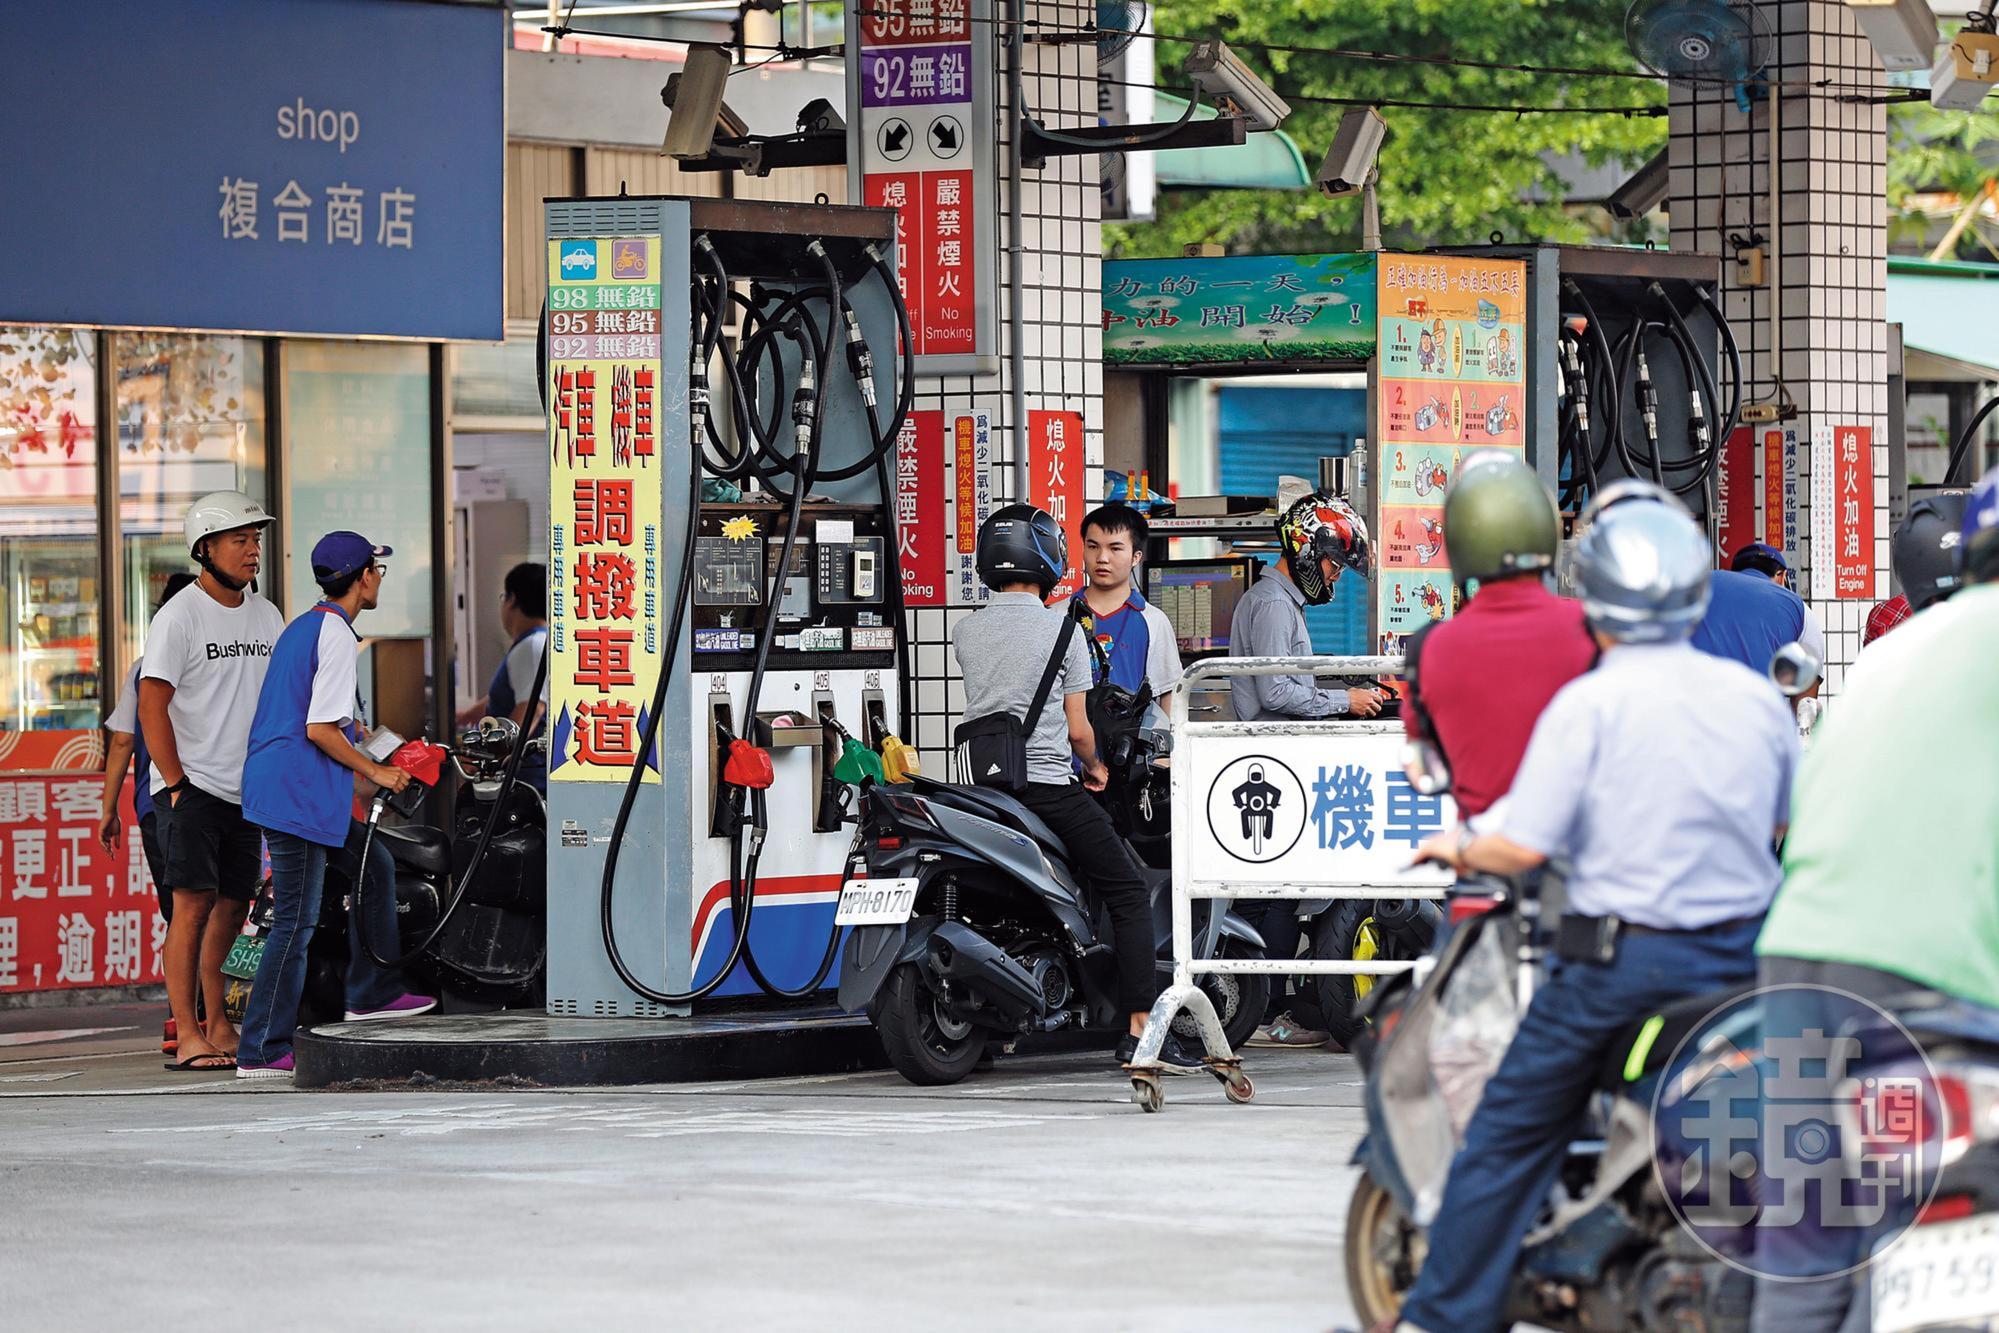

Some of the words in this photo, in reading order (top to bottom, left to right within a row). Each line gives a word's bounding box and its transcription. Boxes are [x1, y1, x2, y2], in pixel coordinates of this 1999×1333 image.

[873, 53, 965, 98] 92無鉛
[277, 97, 360, 153] shop
[218, 176, 416, 250] 複合商店
[936, 178, 961, 298] 嚴禁煙火
[552, 288, 588, 309] 98
[594, 286, 656, 309] 無鉛
[552, 312, 588, 334] 95
[594, 310, 656, 334] 無鉛
[941, 307, 959, 319] No
[926, 326, 972, 341] Smoking
[552, 337, 588, 359] 92
[594, 335, 656, 359] 無鉛
[1047, 418, 1066, 523] 熄火加
[957, 420, 973, 551] 機車熄火等候加油
[1842, 432, 1860, 558] 熄火加油
[961, 554, 973, 601] 謝謝您
[1837, 564, 1856, 576] Turn
[1856, 564, 1867, 576] Off
[903, 584, 934, 598] oking
[1051, 585, 1073, 597] gine
[1839, 578, 1865, 591] Engine
[573, 479, 638, 767] 調撥車道
[206, 640, 273, 660] Bushwick
[712, 675, 726, 689] 404
[1310, 764, 1446, 850] 機車
